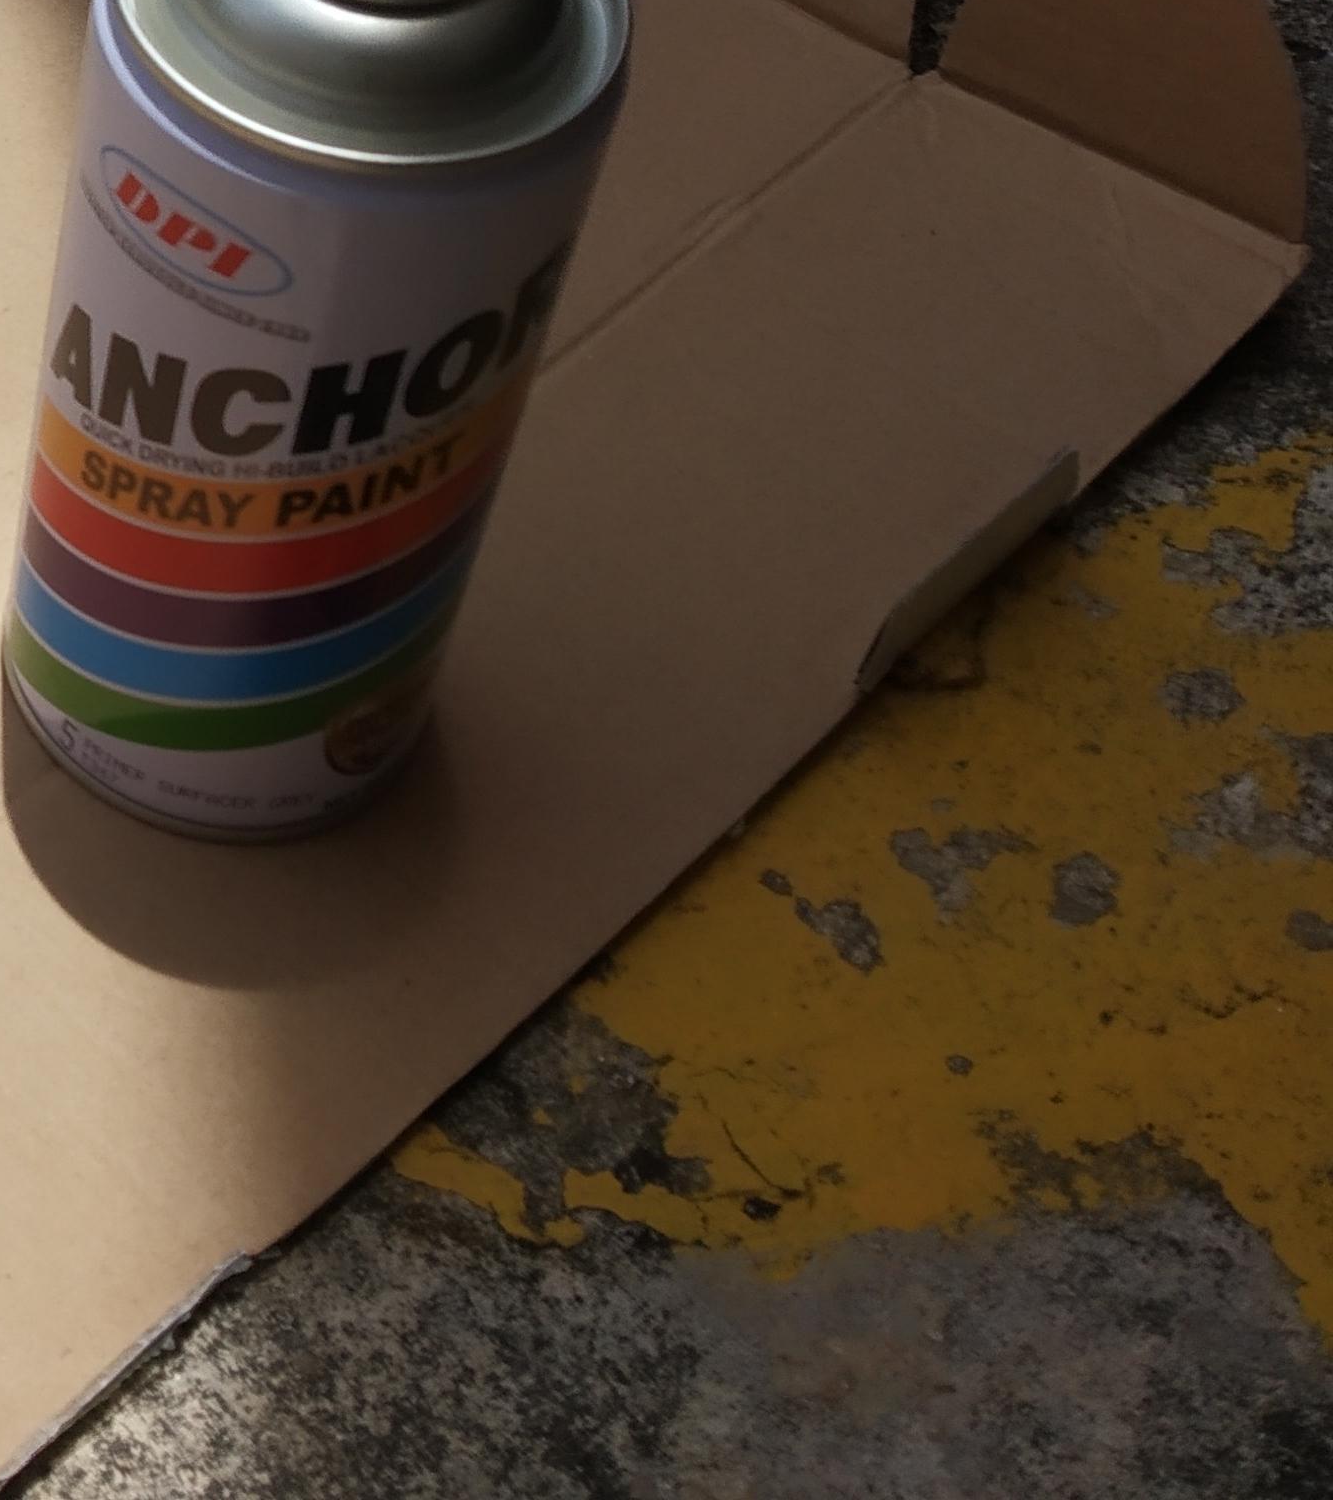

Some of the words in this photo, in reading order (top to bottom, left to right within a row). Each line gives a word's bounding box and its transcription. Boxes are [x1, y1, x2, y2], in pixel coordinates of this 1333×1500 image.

[116, 172, 251, 278] DPI
[81, 449, 256, 528] SPRAY
[276, 431, 465, 528] PAINT
[137, 443, 226, 477] DRYING
